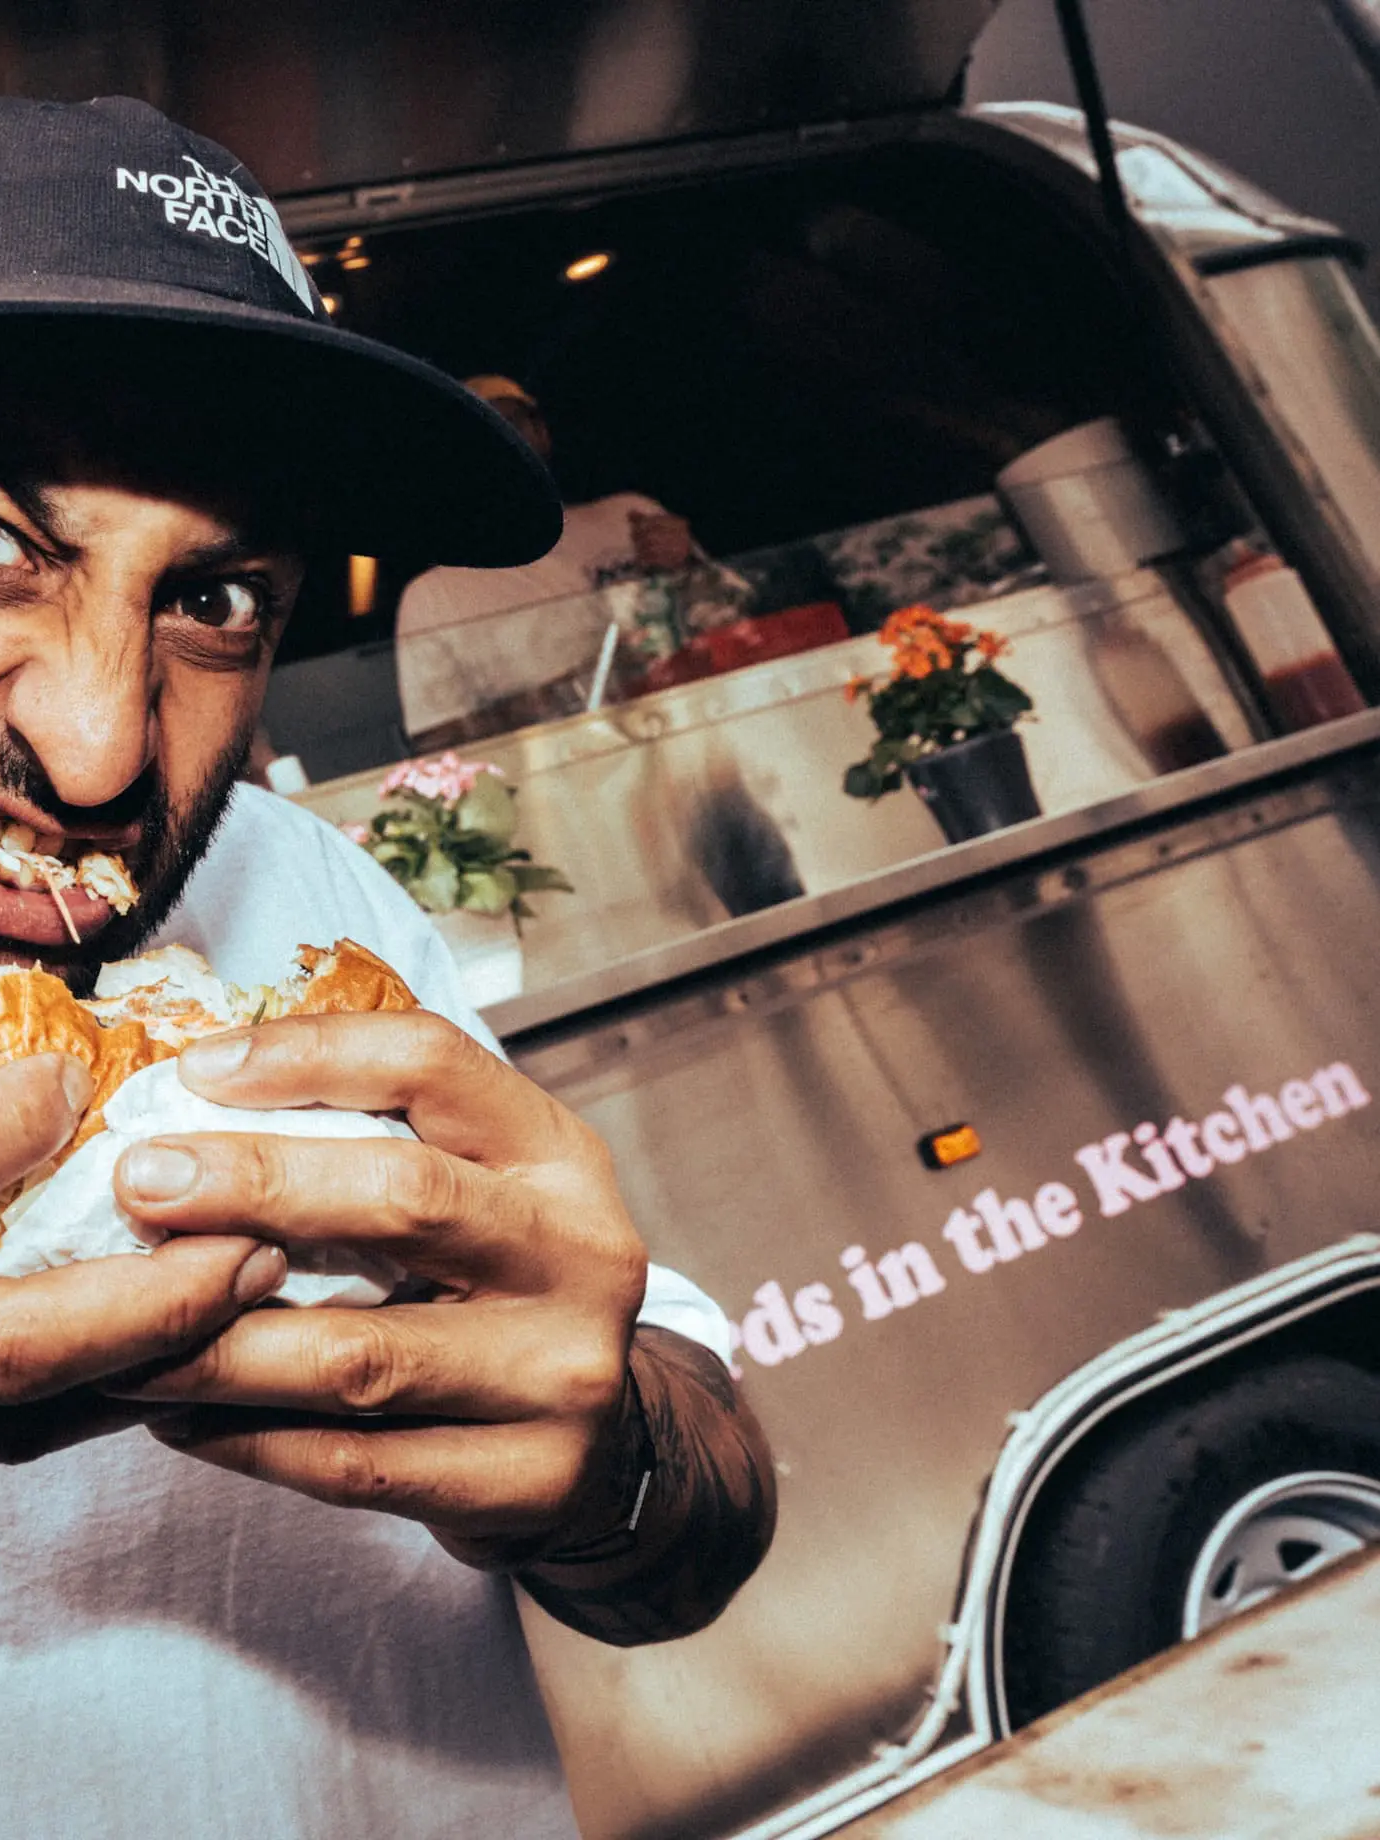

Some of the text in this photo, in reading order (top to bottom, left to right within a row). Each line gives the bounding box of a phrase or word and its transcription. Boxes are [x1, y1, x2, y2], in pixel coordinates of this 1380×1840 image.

[116, 167, 266, 235] NORTH
[181, 155, 253, 205] THE
[164, 199, 270, 261] FACE
[839, 1241, 948, 1321] in
[942, 1182, 1083, 1275] the
[1075, 1061, 1372, 1217] Kitchen
